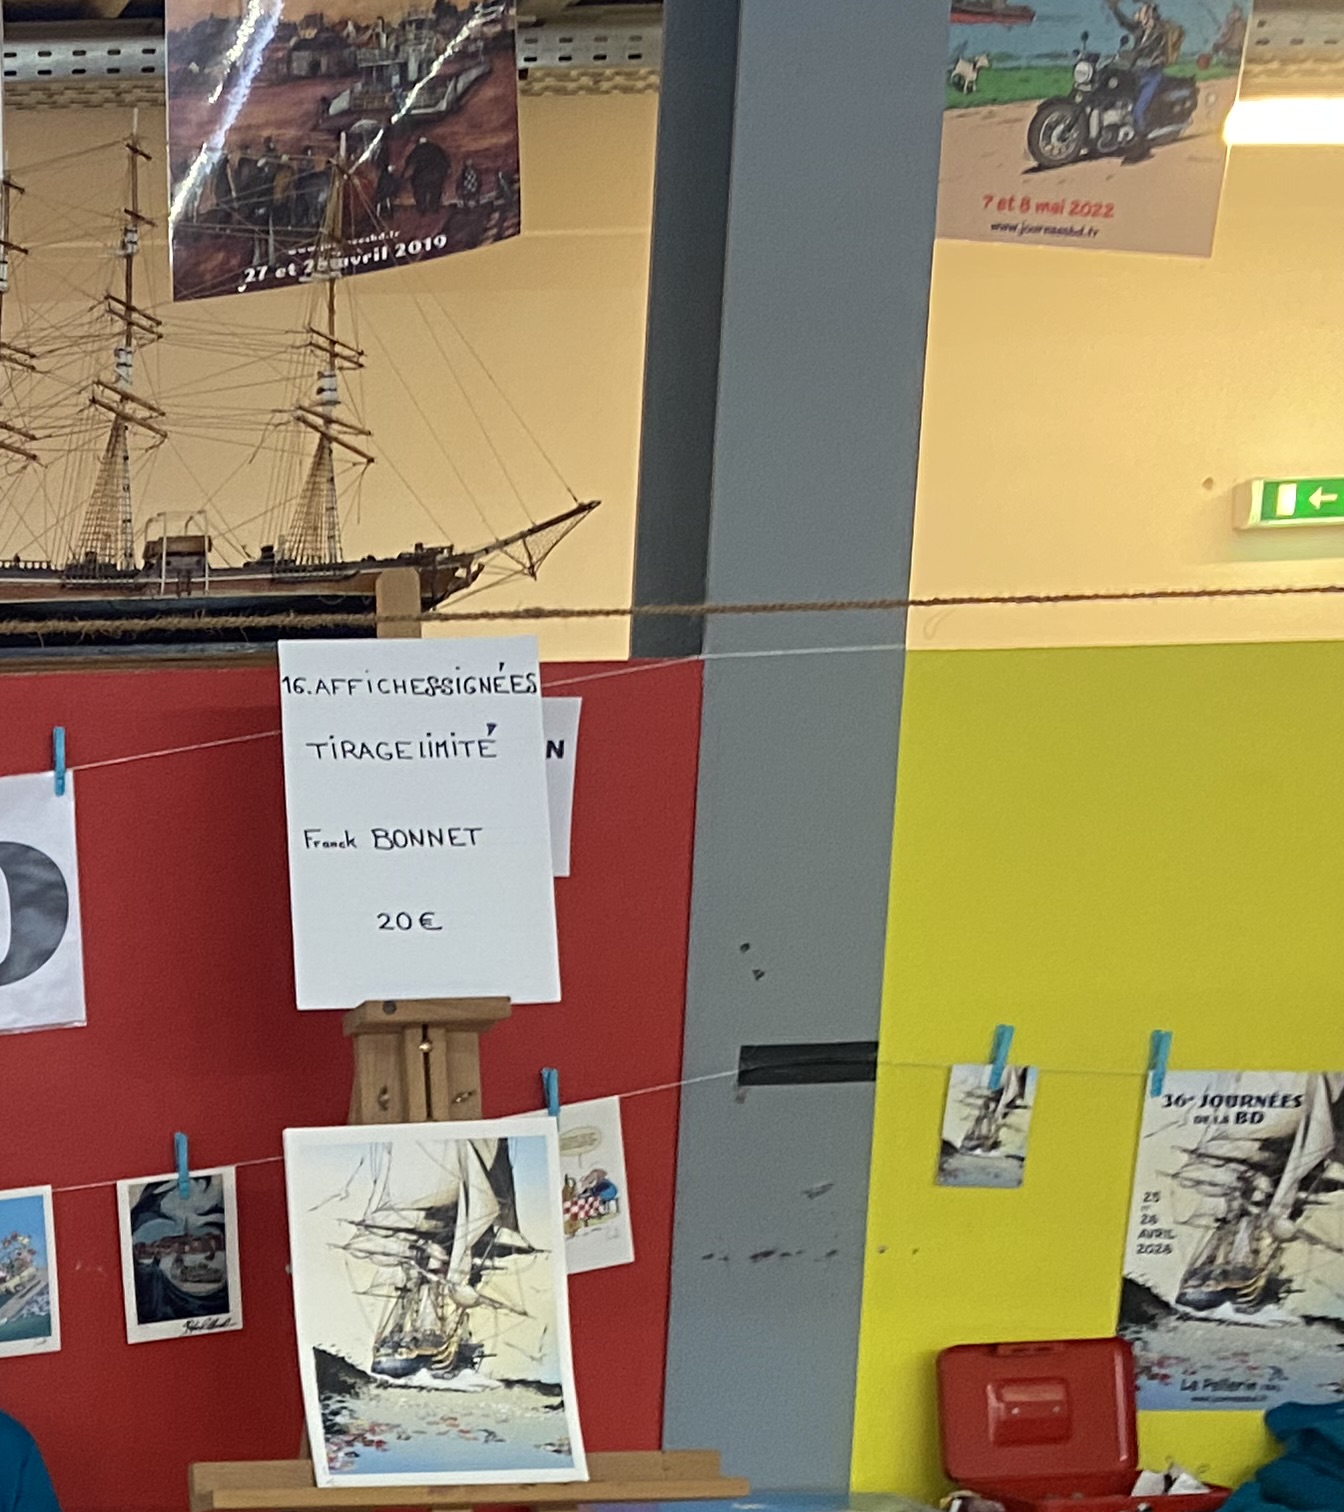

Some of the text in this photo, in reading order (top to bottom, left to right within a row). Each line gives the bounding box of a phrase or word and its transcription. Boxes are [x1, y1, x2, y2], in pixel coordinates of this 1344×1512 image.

[983, 194, 1115, 219] 7 et 8 mai 2022
[244, 234, 447, 284] 27 et 2019
[304, 827, 483, 851] Franck BONNET
[1198, 1092, 1304, 1108] JOURNÉES
[1235, 1112, 1264, 1125] BD
